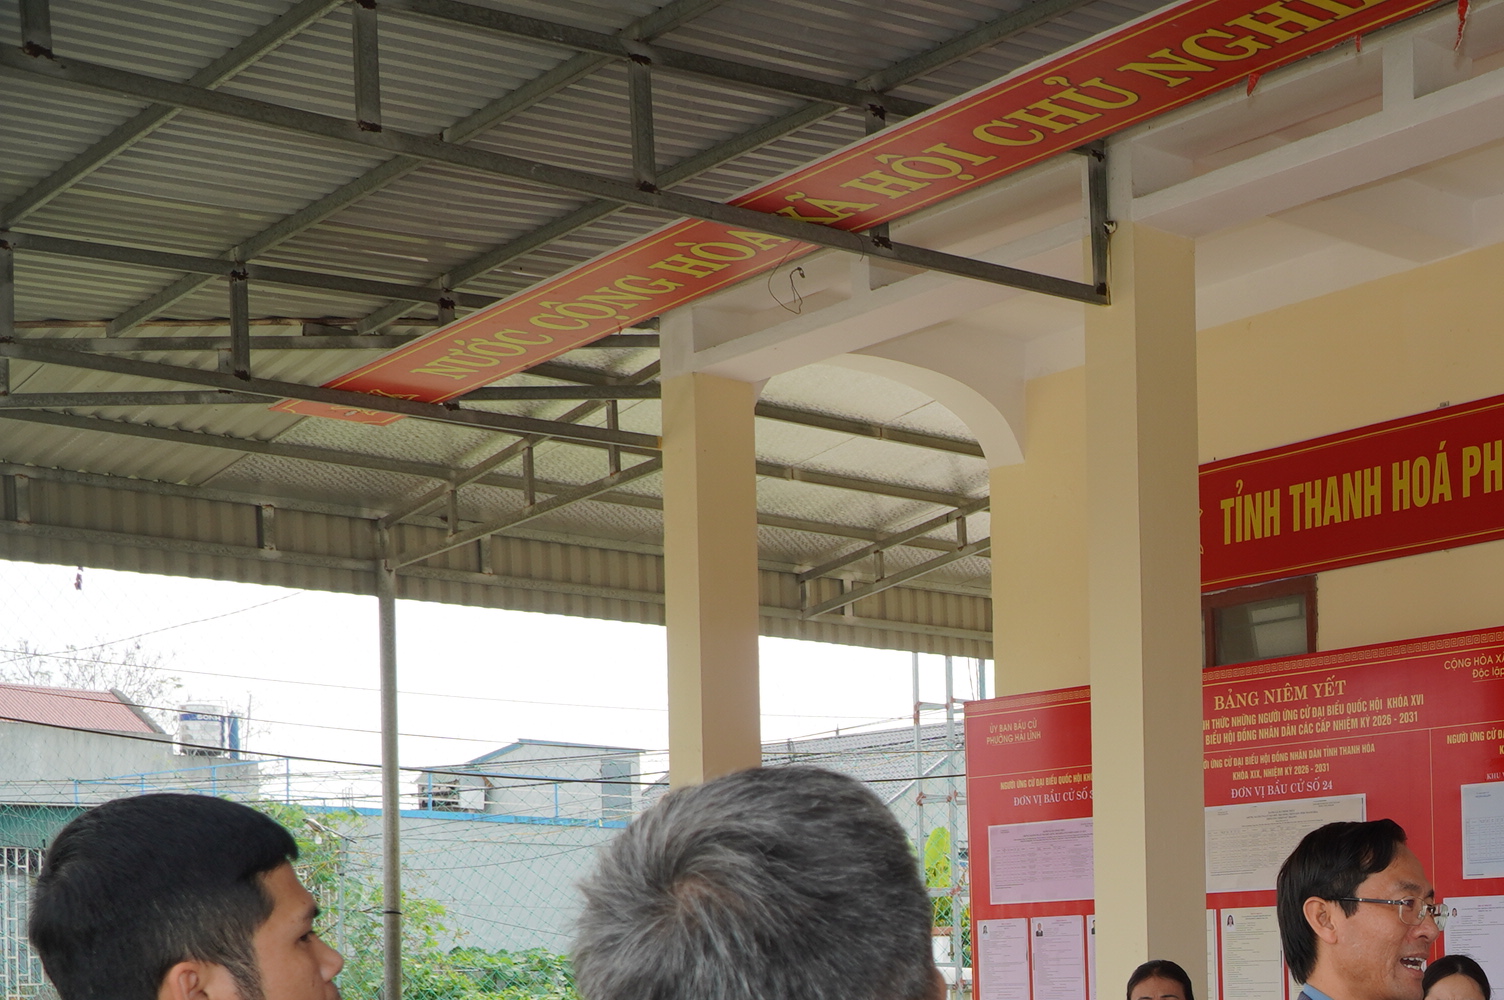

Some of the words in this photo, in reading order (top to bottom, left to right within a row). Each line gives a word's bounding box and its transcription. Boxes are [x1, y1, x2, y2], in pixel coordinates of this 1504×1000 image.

[411, 328, 553, 382] NƯỚC
[530, 272, 684, 331] CỘNG
[643, 230, 793, 279] HÒA
[840, 143, 999, 199] HỘI
[972, 75, 1141, 147] CHỦ
[1220, 478, 1281, 546] TỈNH
[1289, 465, 1383, 531] THANH
[1392, 440, 1452, 512] HOÁ
[1444, 658, 1472, 671] CỘNG
[1473, 653, 1494, 666] HÒA
[1472, 668, 1490, 680] Độc
[1213, 689, 1259, 711] BẢNG
[1264, 683, 1308, 705] NIÊM
[1311, 675, 1347, 698] YẾT
[1211, 716, 1230, 730] THỨC
[1231, 712, 1257, 727] NHỮNG
[1258, 710, 1281, 724] NGƯỜI
[1282, 707, 1298, 721] ỨNG
[1300, 704, 1312, 719] CỬ
[1312, 704, 1325, 718] ĐẠI
[1327, 700, 1345, 716] BIỂU
[1347, 697, 1367, 714] QUỐC
[1369, 696, 1383, 712] HỘI
[1387, 693, 1409, 709] KHÓA
[1410, 693, 1424, 706] XVI
[999, 723, 1013, 732] BAN
[1205, 729, 1222, 746] BIỂU
[1223, 729, 1236, 746] HỘI
[1237, 725, 1257, 742] ĐỒNG
[1258, 724, 1279, 740] NHÂN
[1281, 722, 1297, 738] DÂN
[1298, 721, 1314, 736] CÁC
[1315, 718, 1331, 734] CẤP
[1333, 716, 1358, 733] NHIỆM
[1360, 714, 1371, 729] KỲ
[1372, 713, 1392, 727] 2026
[1399, 711, 1418, 725] 2031
[1447, 731, 1468, 744] NGƯỜI
[1470, 728, 1485, 743] ỨNG
[1486, 725, 1497, 740] CỬ
[1233, 756, 1244, 768] ĐẠI
[1245, 752, 1259, 766] BIỂU
[1260, 752, 1271, 766] HỘI
[1271, 750, 1289, 764] ĐỒNG
[1290, 749, 1308, 762] NHÂN
[1309, 747, 1322, 759] DÂN
[1339, 745, 1361, 757] THANH
[1361, 743, 1376, 754] HÓA
[1083, 773, 1092, 782] KH
[1232, 770, 1249, 781] KHÓA
[1263, 766, 1284, 779] NHIỆM
[1284, 764, 1293, 776] KỲ
[1294, 764, 1310, 774] 2026
[1314, 763, 1330, 773] 2031
[1014, 794, 1031, 806] ĐƠN
[1032, 794, 1042, 806] VỊ
[1044, 788, 1061, 804] BẦU
[1063, 787, 1075, 802] CỬ
[1076, 786, 1088, 800] SỐ
[1231, 786, 1253, 799] ĐƠN
[1253, 785, 1266, 799] VỊ
[1267, 779, 1288, 796] BẦU
[1290, 778, 1306, 793] CỬ
[1306, 776, 1320, 792] SỐ
[1322, 780, 1333, 791] 24
